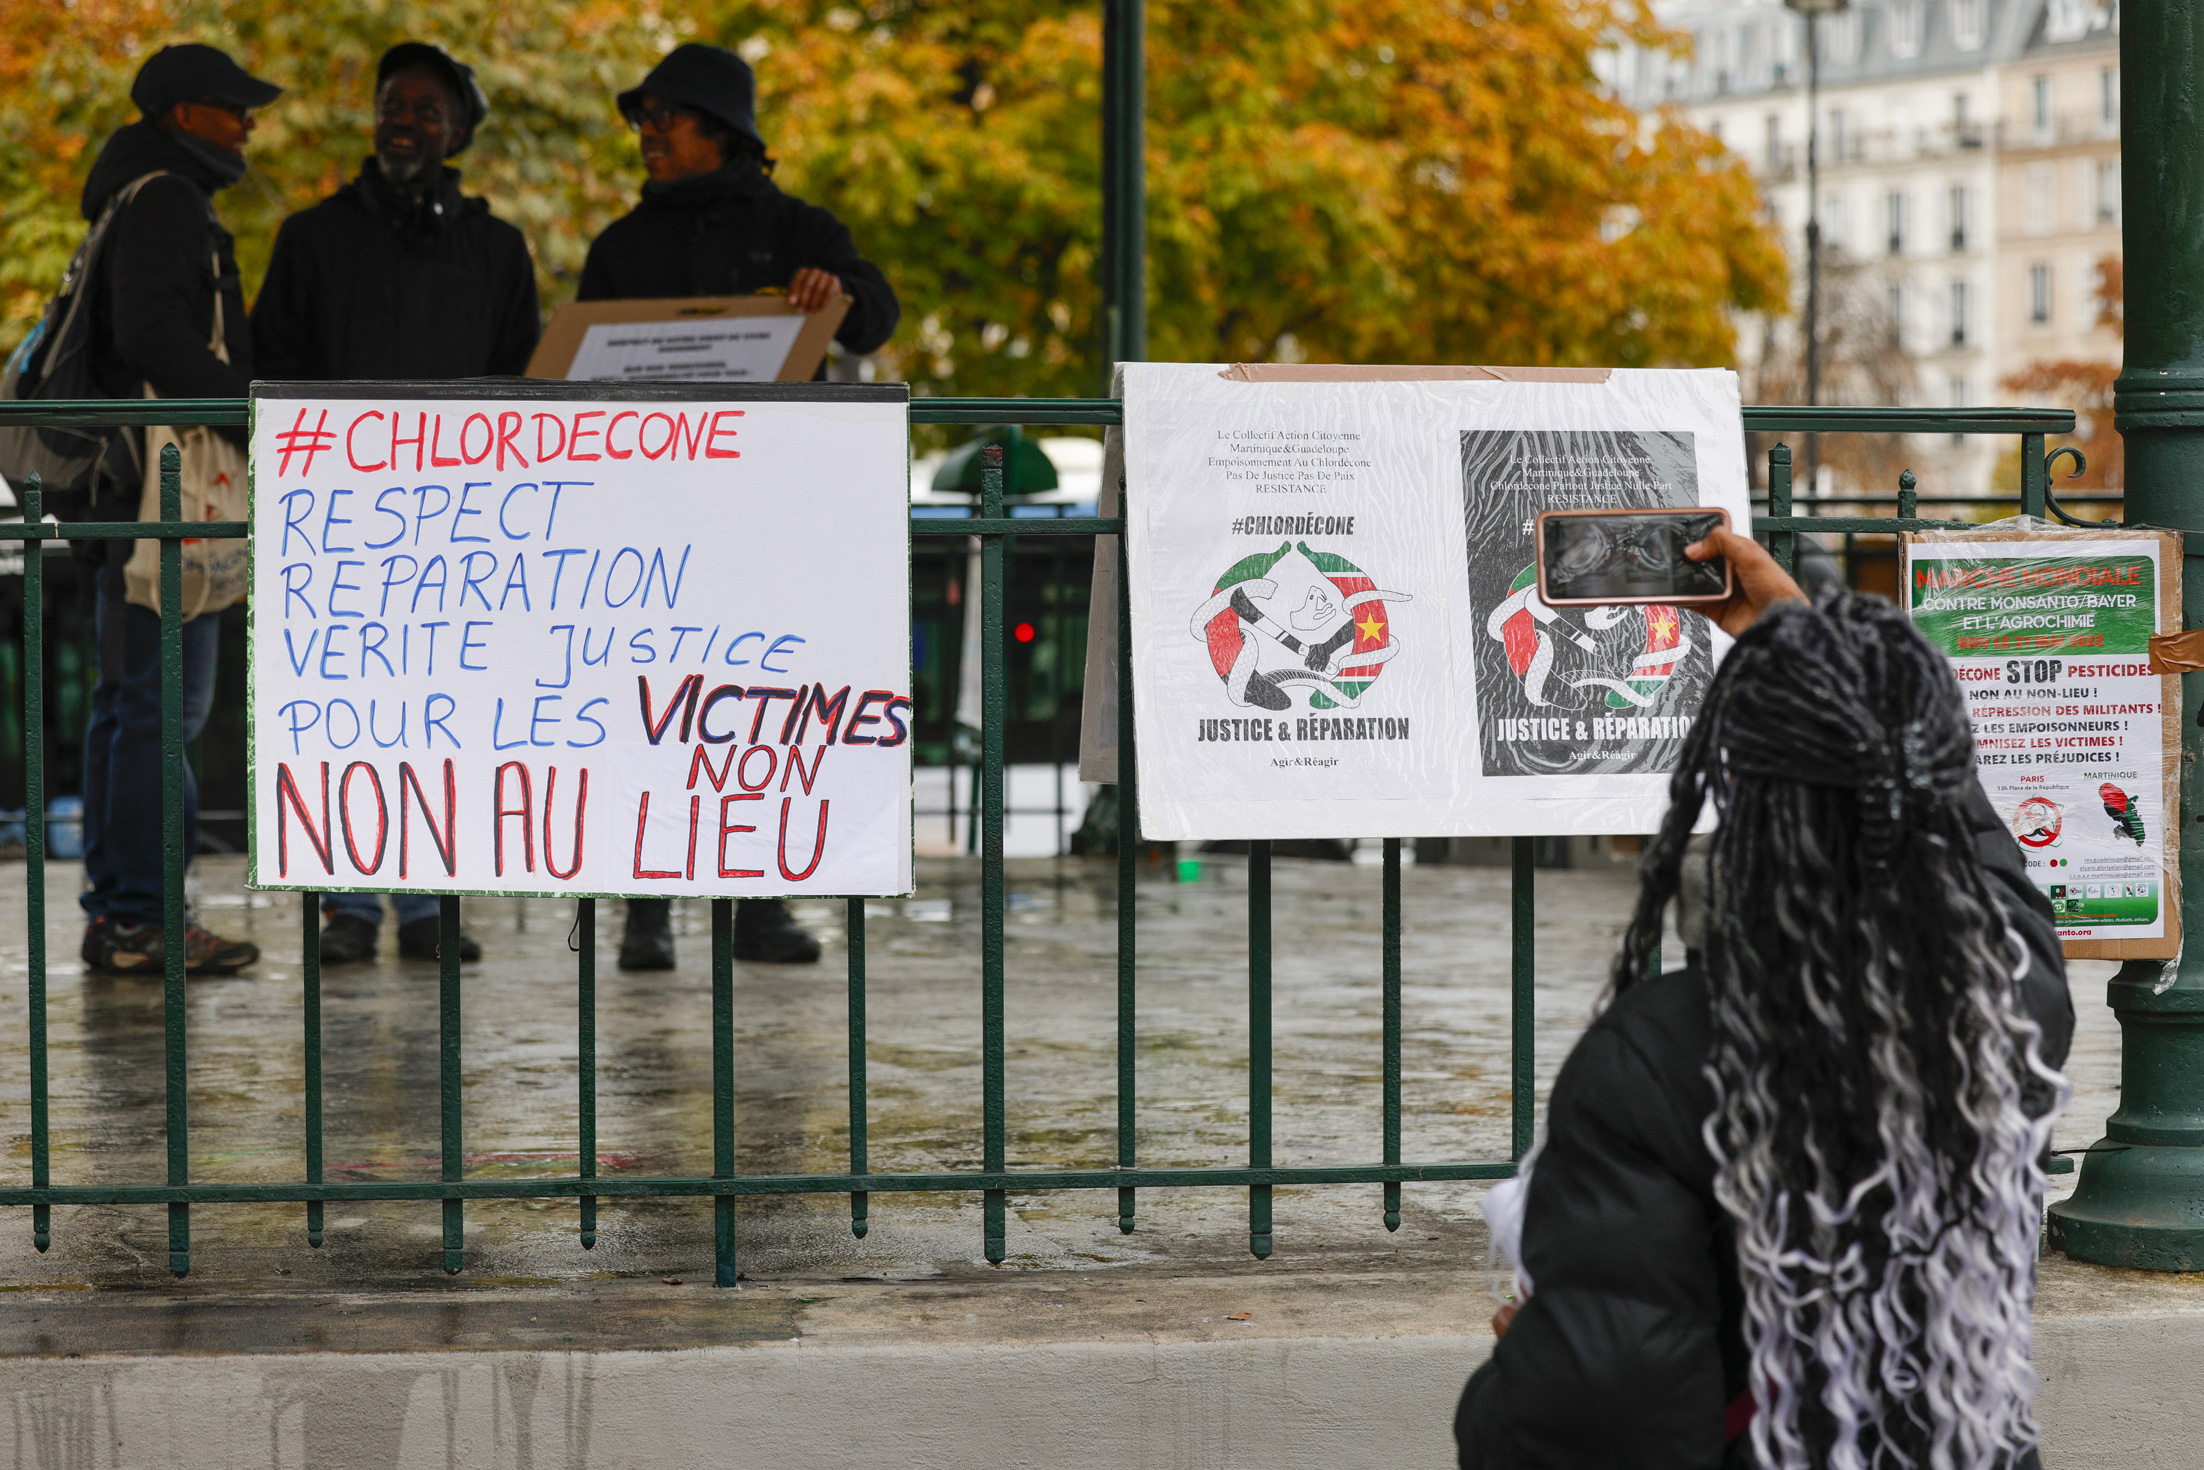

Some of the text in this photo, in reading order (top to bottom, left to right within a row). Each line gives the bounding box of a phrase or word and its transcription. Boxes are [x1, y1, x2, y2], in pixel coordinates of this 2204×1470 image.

[275, 408, 746, 478] #CHLORDECONE
[1217, 430, 1361, 442] Le Collectif Action Citoyenne
[1230, 443, 1350, 456] Martinique&Guadeloupe
[1208, 457, 1372, 468] Empoisonnement Au Chlordécone
[1510, 454, 1650, 466] Le Collectif Action Citoyenne
[1226, 471, 1355, 480] Pas De Justice Pas De Paix
[1522, 468, 1640, 479] Martinique&Guadeloupe
[1256, 484, 1327, 494] RESISTANCE
[1490, 481, 1672, 491] Chlordécone Partout Justice Nulle Part
[1547, 494, 1618, 504] RESISTANCE
[278, 481, 595, 557] RESPECT
[1231, 512, 1355, 536] #CHLORDÉCONE
[280, 544, 692, 620] REPARATION
[1916, 566, 2142, 589] MARCHE MONDIALE
[1923, 594, 2137, 611] CONTRE MONSANTO/BAYER
[1963, 616, 1985, 630] ET
[1958, 634, 2104, 650] RDV LE 21 MAI 2022
[283, 621, 807, 689] VERITE JUSTICE
[2006, 660, 2062, 684] STOP
[1969, 690, 1999, 700] NON
[2004, 689, 2022, 700] AU
[2026, 688, 2090, 699] NON-LIEU
[278, 675, 912, 755] POUR LES VICTIMES
[1972, 705, 2051, 718] RÉPRESSION
[2056, 706, 2079, 716] DES
[2083, 704, 2154, 716] MILITANTS
[1198, 712, 1410, 742] JUSTICE & RÉPARATION
[1497, 712, 1697, 742] JUSTICE & RÉPARATIO
[1984, 723, 2005, 734] LES
[2009, 721, 2120, 733] EMPOISONNEURS
[1976, 738, 2026, 750] MNISEZ
[2030, 738, 2051, 748] LES
[2055, 736, 2116, 748] VICTIMES
[1270, 757, 1339, 768] Agir&Réagir
[1568, 750, 1635, 762] Agir&Réagir
[1975, 754, 2007, 765] AREZ
[2011, 753, 2032, 764] LES
[2036, 750, 2112, 764] PRÉJUDICES
[686, 745, 827, 797] NON
[2084, 772, 2138, 780] MARTINIQUE
[276, 758, 830, 883] NON AU LIEU
